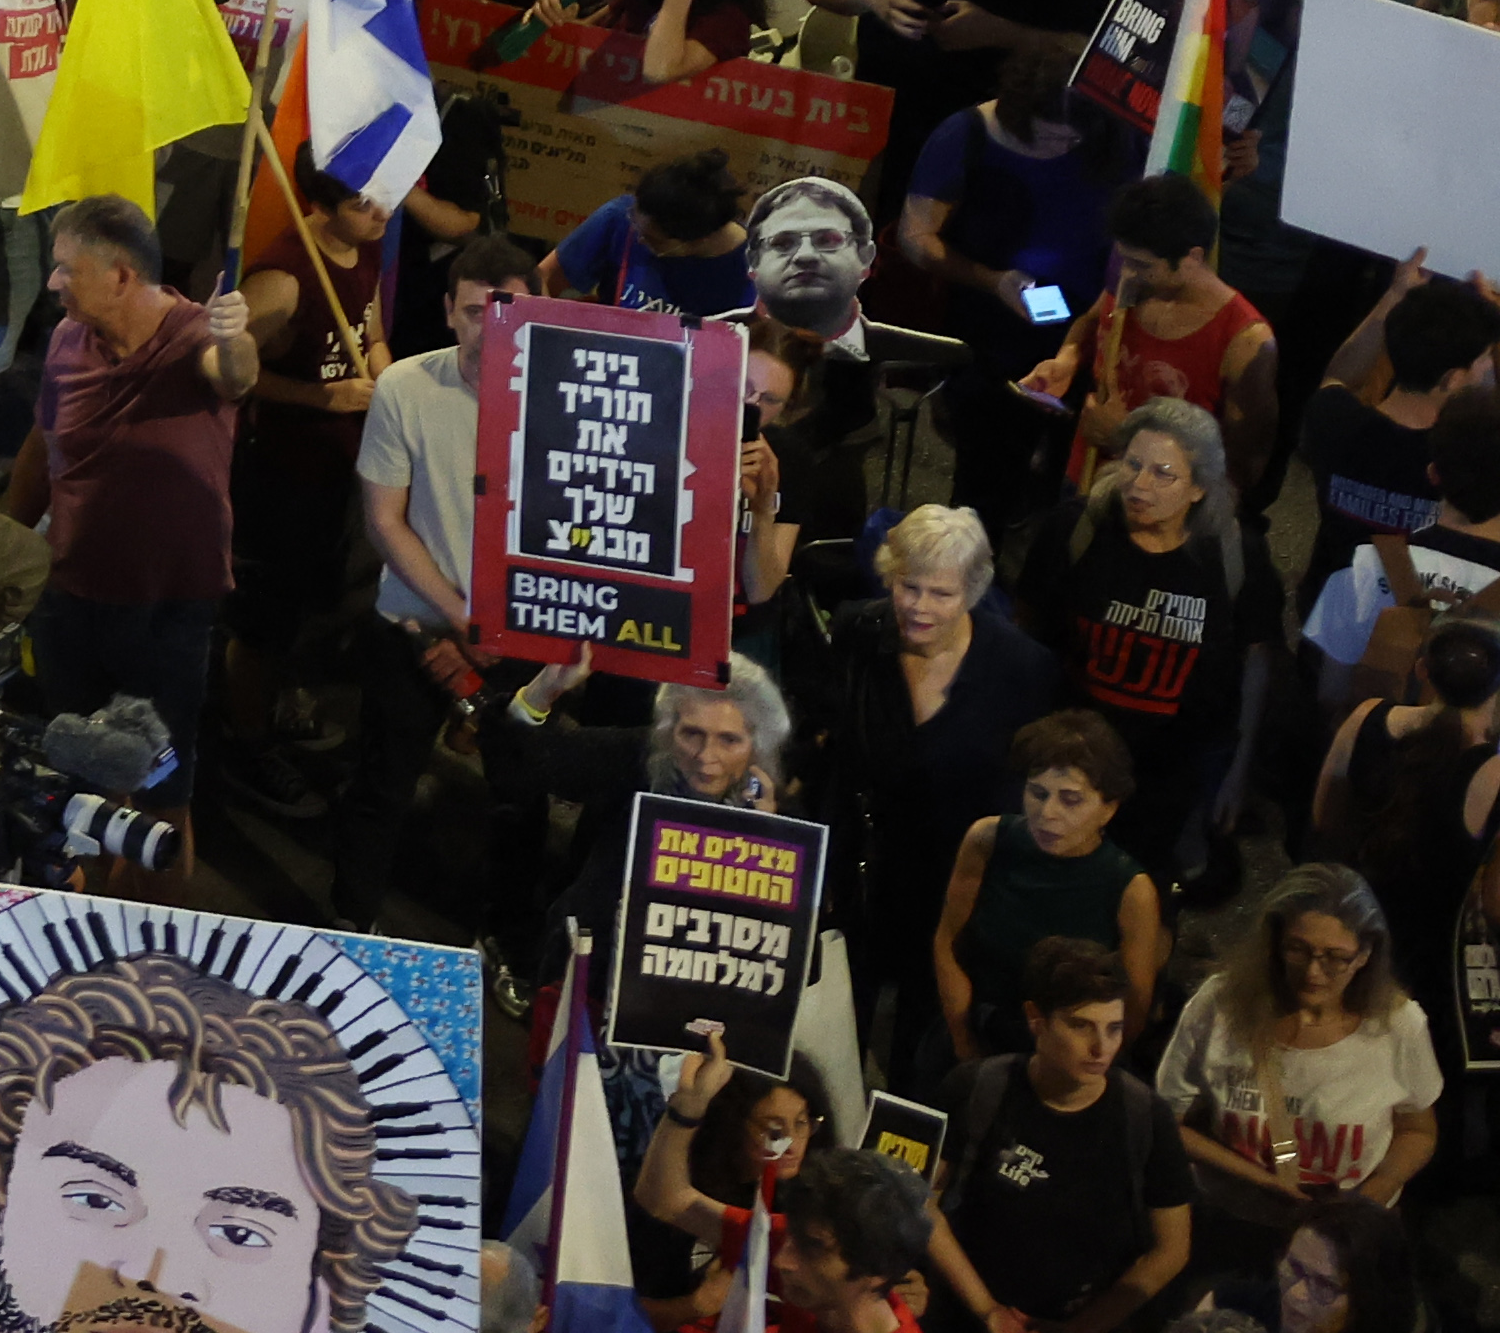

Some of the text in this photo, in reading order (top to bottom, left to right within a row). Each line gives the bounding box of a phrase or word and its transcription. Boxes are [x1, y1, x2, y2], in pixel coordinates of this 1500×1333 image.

[811, 96, 870, 134] בית
[574, 347, 640, 389] ביבי
[558, 384, 650, 426] תוריד
[575, 419, 629, 459] את
[547, 451, 654, 496] הידיים
[564, 487, 634, 531] שלך
[512, 571, 619, 613] BRING
[1146, 588, 1207, 619] מחזירים
[512, 603, 682, 654] THEM ALL
[658, 825, 797, 871] מצילים את
[654, 857, 793, 906] החטופים
[646, 905, 791, 955] מסרבים
[641, 943, 785, 997] למלחמה
